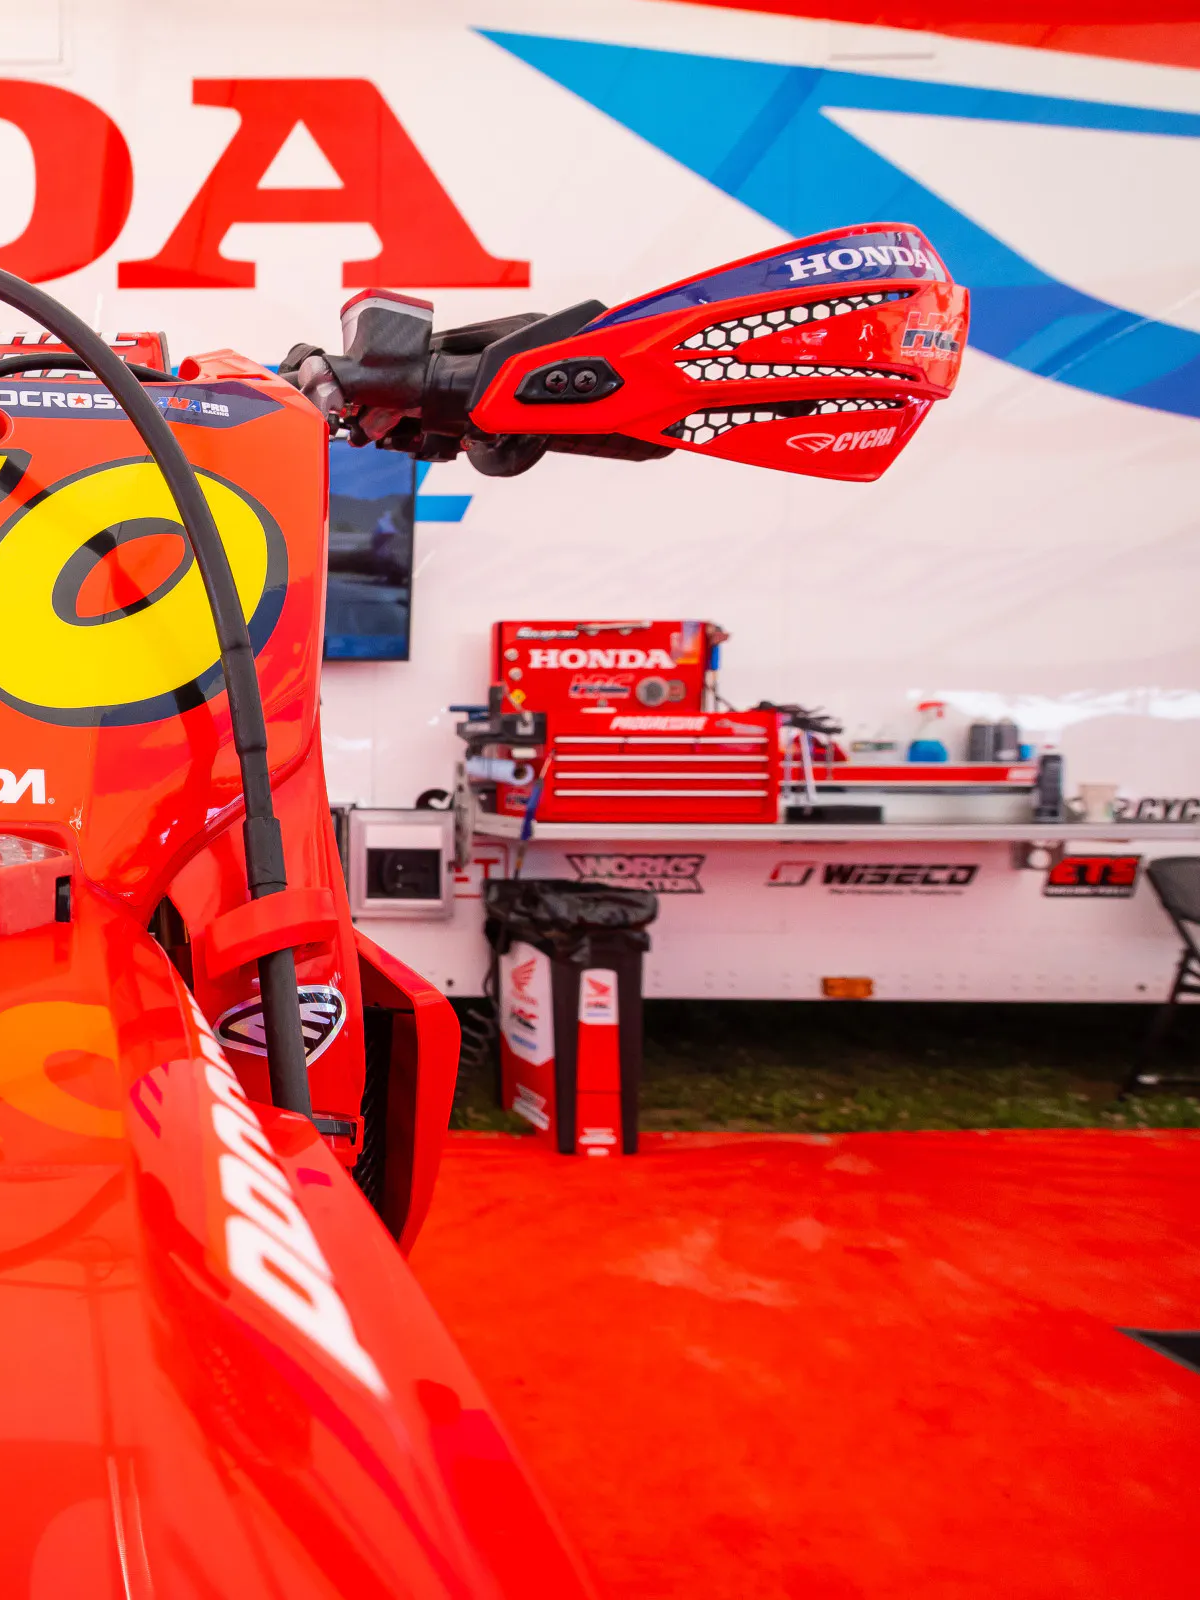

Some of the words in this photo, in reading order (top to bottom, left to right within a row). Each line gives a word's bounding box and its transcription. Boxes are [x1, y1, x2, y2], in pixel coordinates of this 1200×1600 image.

[784, 244, 934, 281] HONDA
[832, 426, 898, 452] CYCRA
[528, 648, 677, 669] HONDA
